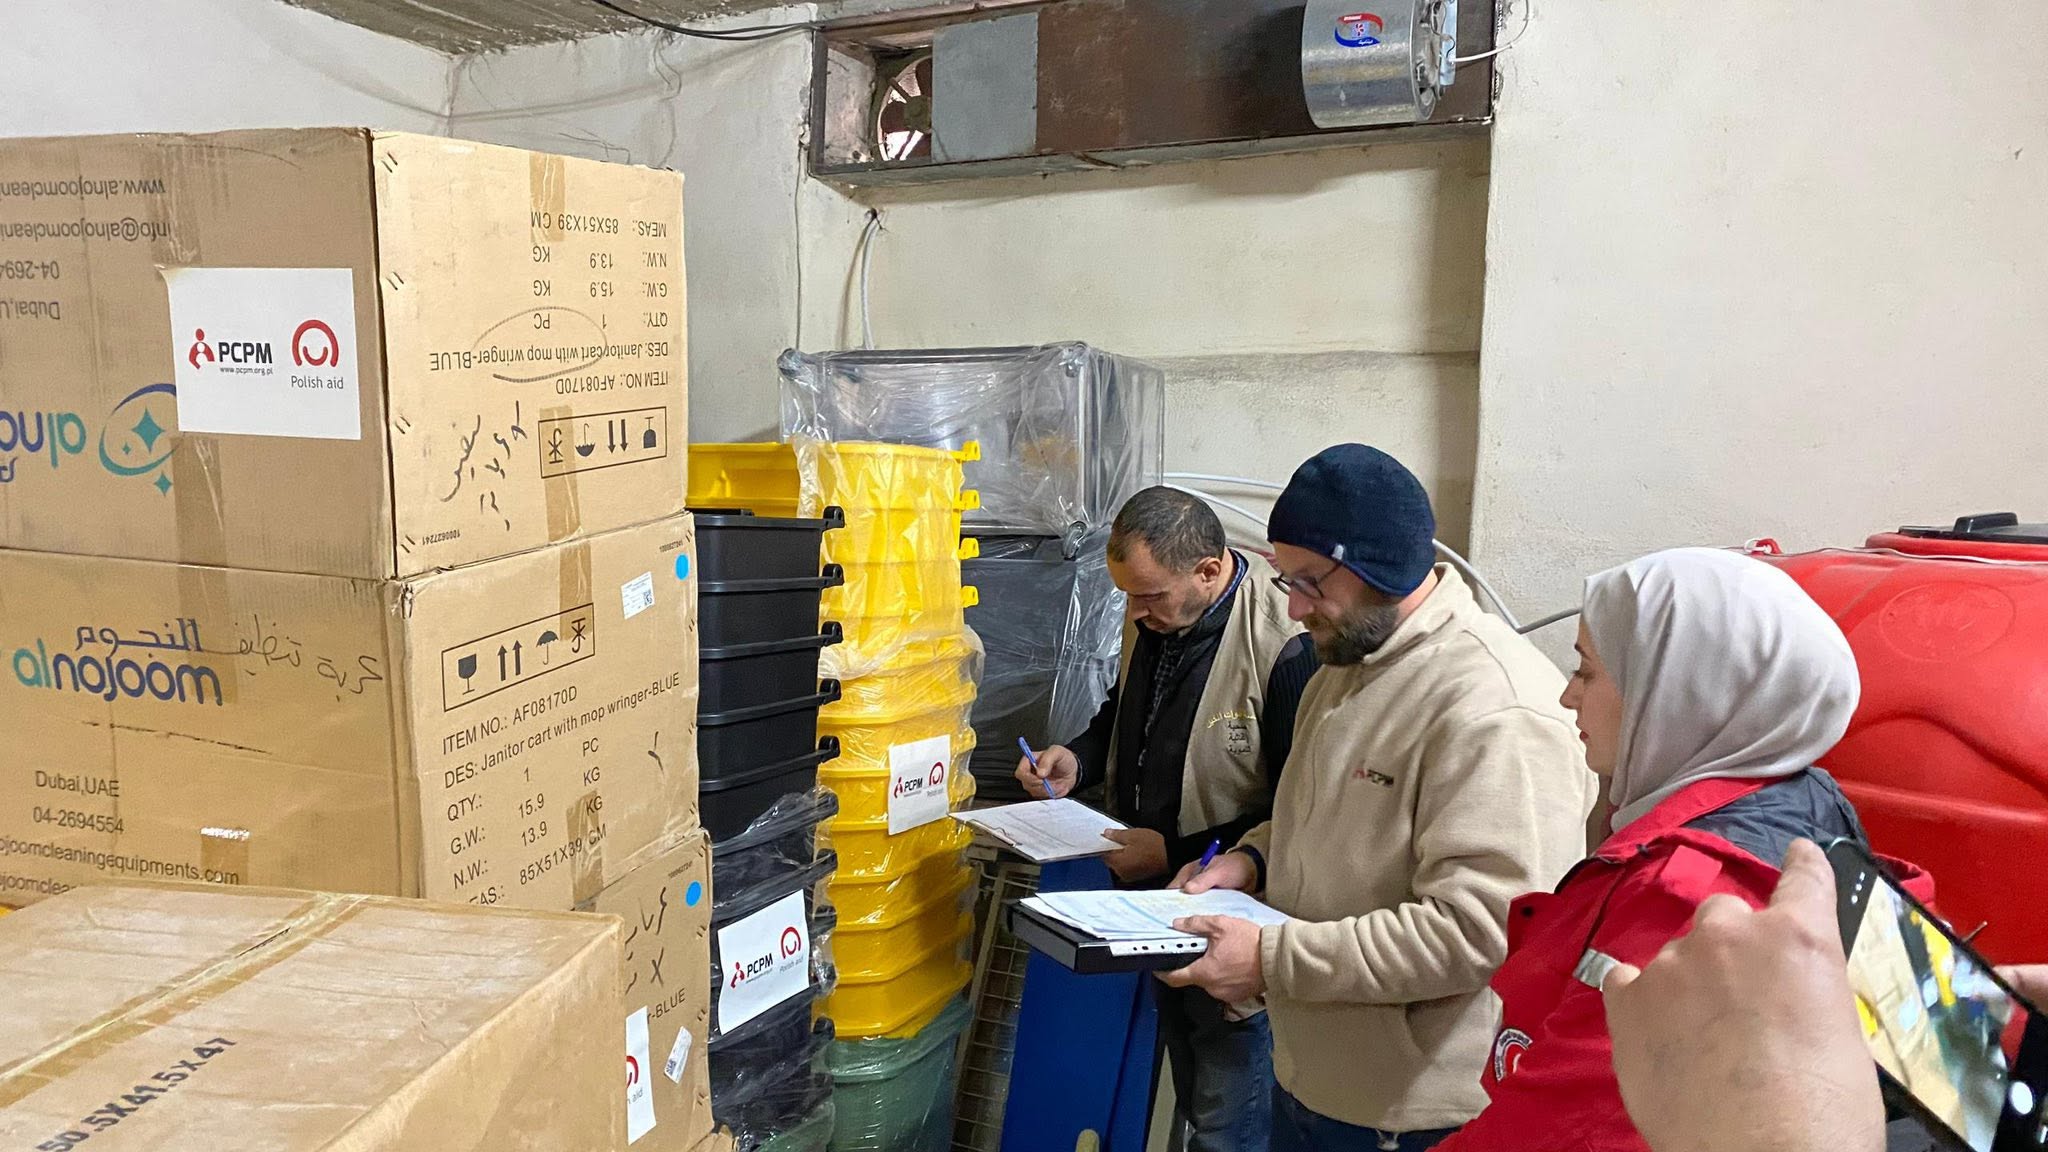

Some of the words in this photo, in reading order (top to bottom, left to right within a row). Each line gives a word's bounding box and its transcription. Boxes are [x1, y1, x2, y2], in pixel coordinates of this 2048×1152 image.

[0, 175, 165, 200] www.alnojoomclean
[530, 211, 551, 229] CM
[558, 213, 619, 234] 85X51X39
[532, 245, 551, 263] KG
[590, 252, 614, 269] 13.9
[533, 279, 551, 296] KG
[590, 281, 614, 298] 15.9
[533, 313, 551, 330] PC
[601, 313, 607, 330] 1
[218, 341, 273, 364] PCPM
[429, 346, 524, 371] wringer-BLUE
[527, 345, 552, 362] mop
[556, 346, 579, 362] with
[582, 346, 603, 360] cart
[605, 344, 641, 359] Janitor
[645, 341, 668, 357] DES:
[219, 366, 273, 376] www.pcpm.org.pl
[644, 371, 668, 387] ITEM
[291, 375, 324, 389] Polish
[326, 377, 344, 390] aid
[556, 374, 614, 395] AF08170D
[75, 617, 202, 658] النجوم
[12, 637, 223, 707] alnojoom
[442, 725, 477, 755] ITEM
[512, 685, 578, 725] AF08170D
[444, 761, 478, 789] DES:
[481, 740, 525, 771] Janitor
[527, 727, 551, 749] cart
[553, 715, 578, 739] with
[580, 706, 605, 727] mop
[607, 671, 680, 714] wringer-BLUE
[524, 767, 531, 783] 1
[582, 737, 599, 757] PC
[35, 769, 120, 798] Dubai,UAE
[518, 792, 545, 819] 15.9
[583, 765, 601, 787] KG
[904, 777, 923, 792] PCPM
[32, 806, 125, 835] 04-2694554
[521, 820, 548, 847] 13.9
[585, 795, 603, 816] KG
[469, 885, 505, 905] AS.:
[519, 836, 583, 886] 85X51X39
[588, 823, 607, 846] CM
[0, 871, 77, 896] joomclea
[746, 952, 774, 978] PCPM
[646, 987, 686, 1025] r-BLUE
